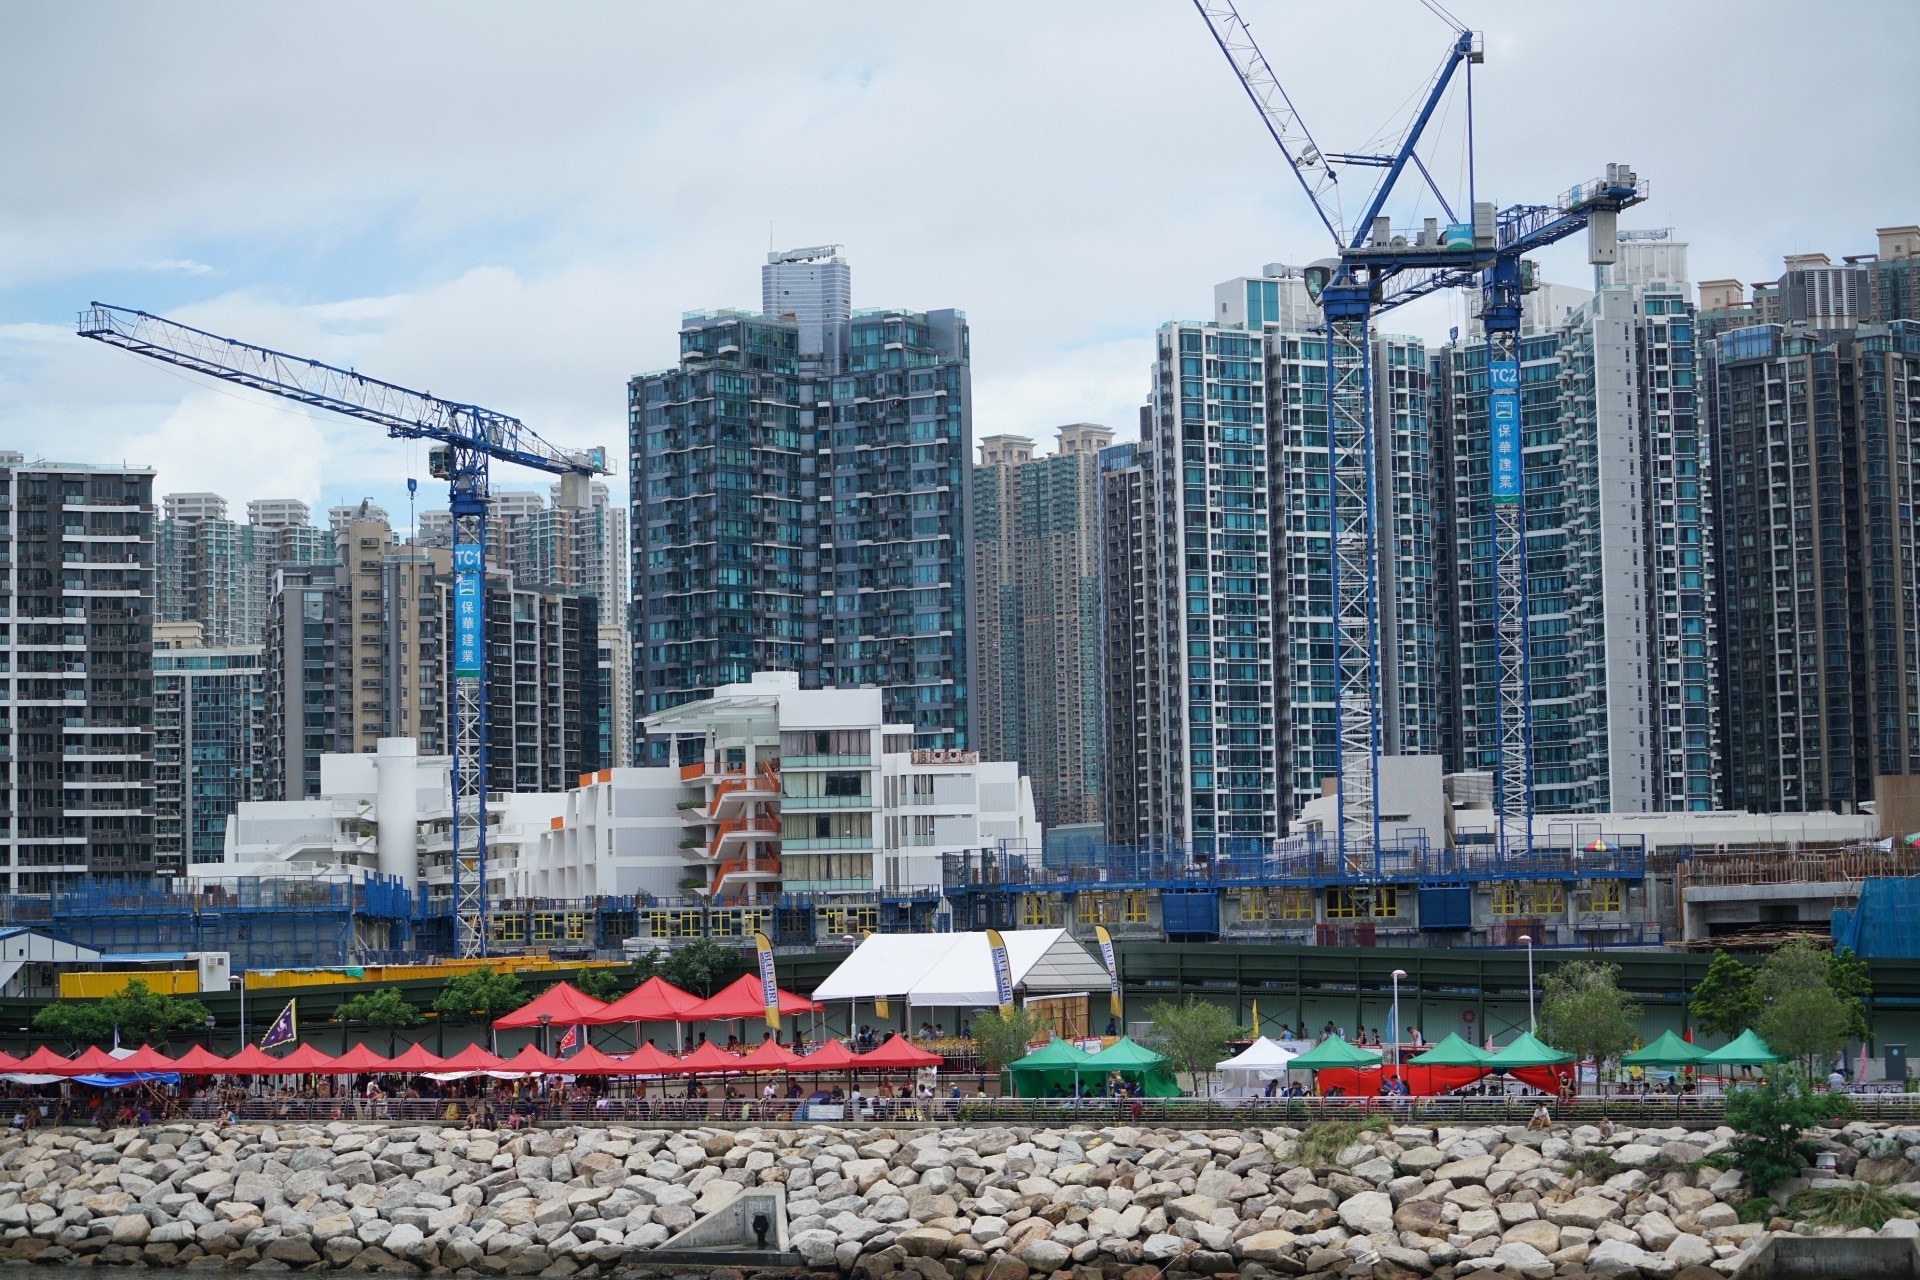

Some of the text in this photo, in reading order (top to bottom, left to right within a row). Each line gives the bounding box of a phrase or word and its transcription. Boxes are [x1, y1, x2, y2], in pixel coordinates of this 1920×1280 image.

[1490, 368, 1517, 382] TC2
[1498, 424, 1512, 488] 保華建業
[455, 551, 480, 565] TC1
[461, 601, 474, 662] 保華建業
[764, 951, 774, 977] BLUE
[996, 947, 1008, 975] BLUE
[1002, 977, 1012, 1004] GIRL
[768, 980, 777, 1006] GIRL
